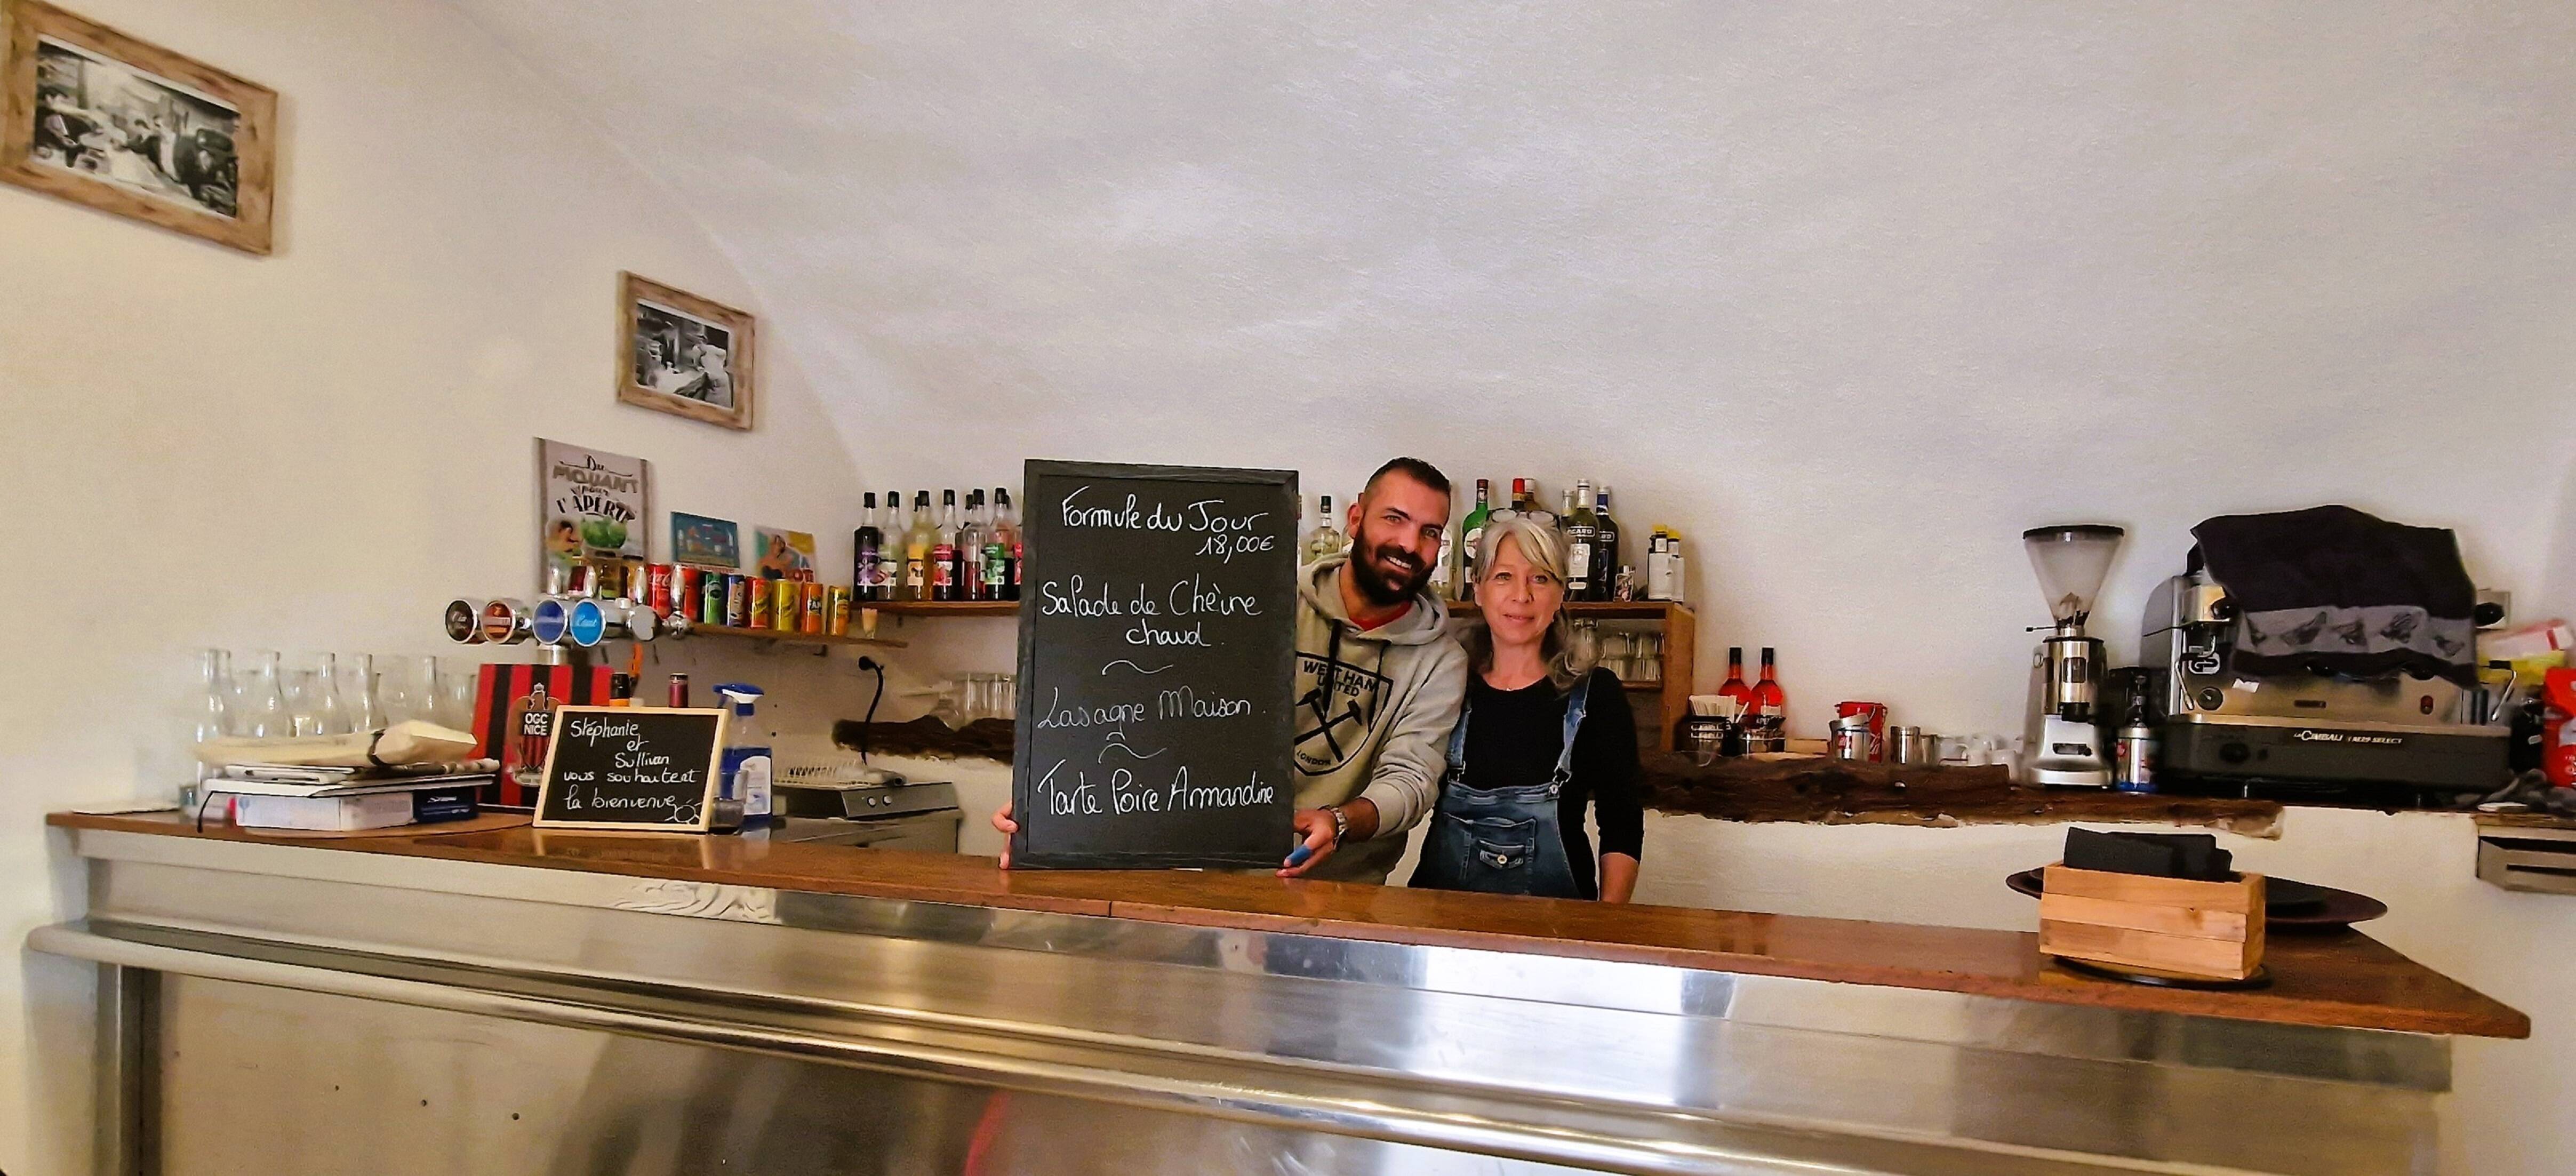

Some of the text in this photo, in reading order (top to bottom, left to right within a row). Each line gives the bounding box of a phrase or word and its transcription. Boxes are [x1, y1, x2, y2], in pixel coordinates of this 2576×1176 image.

[1062, 486, 1269, 532] Formule du Jour
[1195, 534, 1275, 564] 18,00€
[1042, 573, 1263, 618] Salade de Chèvre
[1303, 660, 1375, 692] WET HAM
[525, 713, 548, 725] OGC
[1037, 686, 1146, 740] Lasagne
[524, 724, 548, 735] NICE
[570, 716, 640, 747] Stéphanie
[615, 750, 670, 769] Sullivan
[627, 738, 649, 753] et
[563, 770, 595, 782] vous
[1037, 759, 1274, 815] Tarte Poire Amandine
[564, 785, 677, 811] la bienvenue
